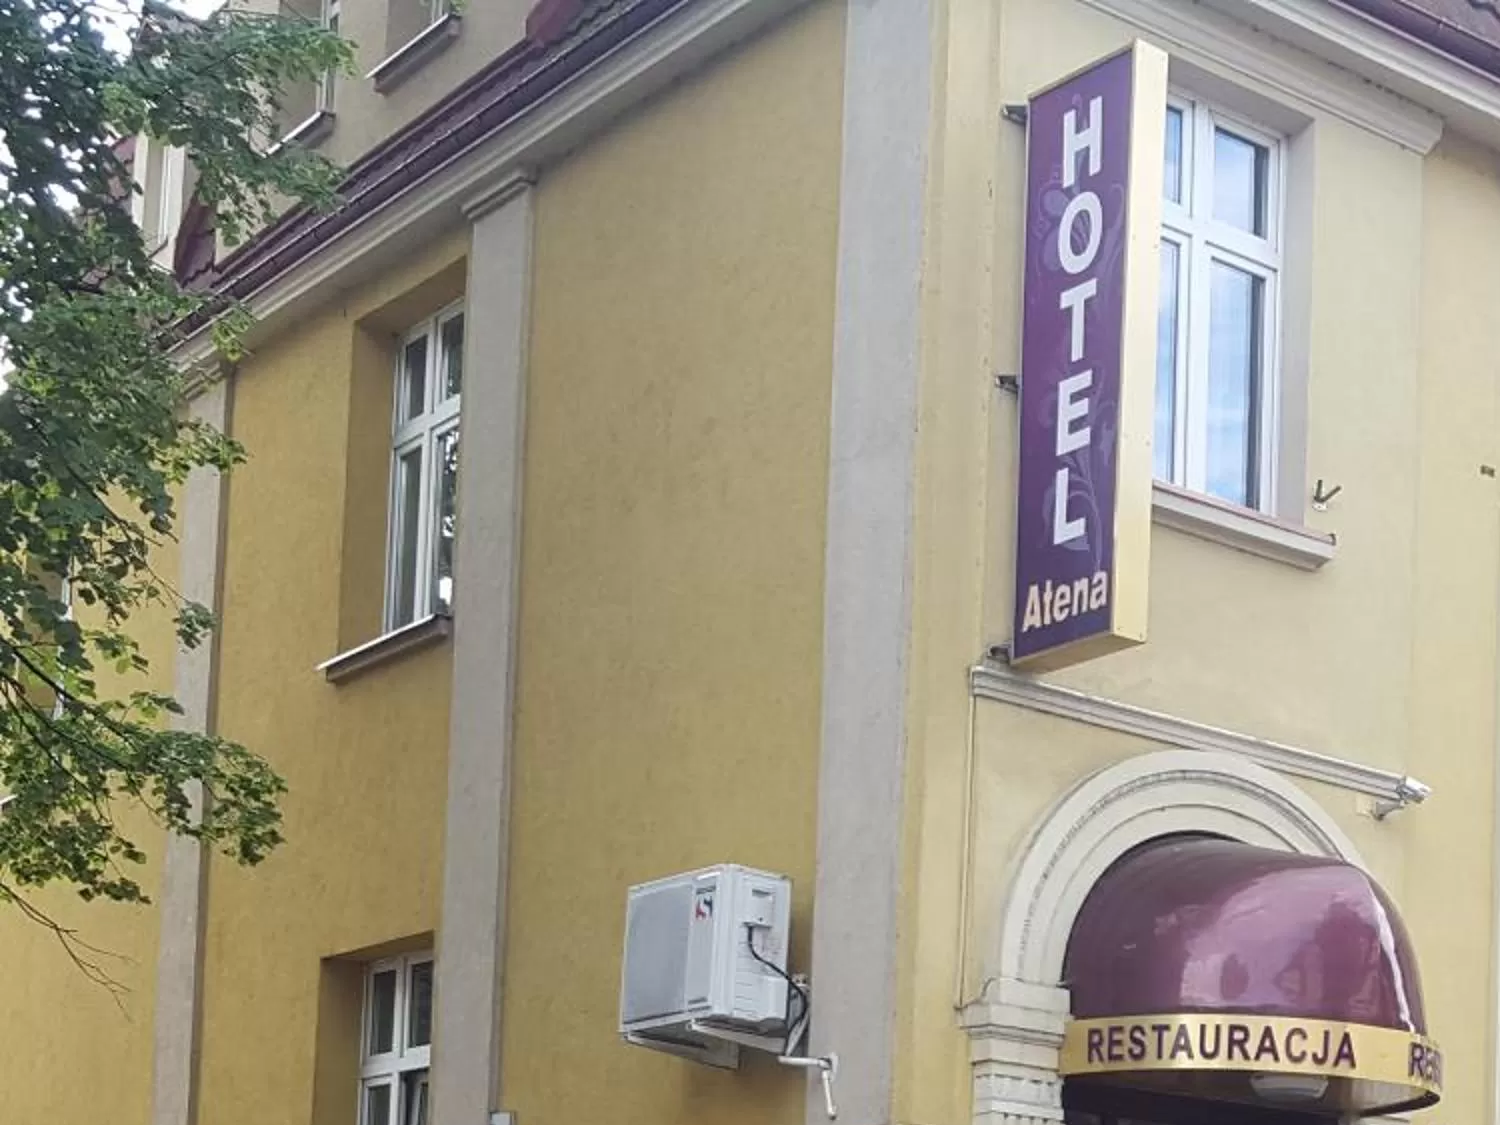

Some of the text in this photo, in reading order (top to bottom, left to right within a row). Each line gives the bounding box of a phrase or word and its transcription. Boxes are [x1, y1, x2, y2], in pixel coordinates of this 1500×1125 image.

[1052, 95, 1103, 547] HOTEL
[1021, 571, 1107, 632] Atena
[1086, 1022, 1357, 1069] RESTAURACJA
